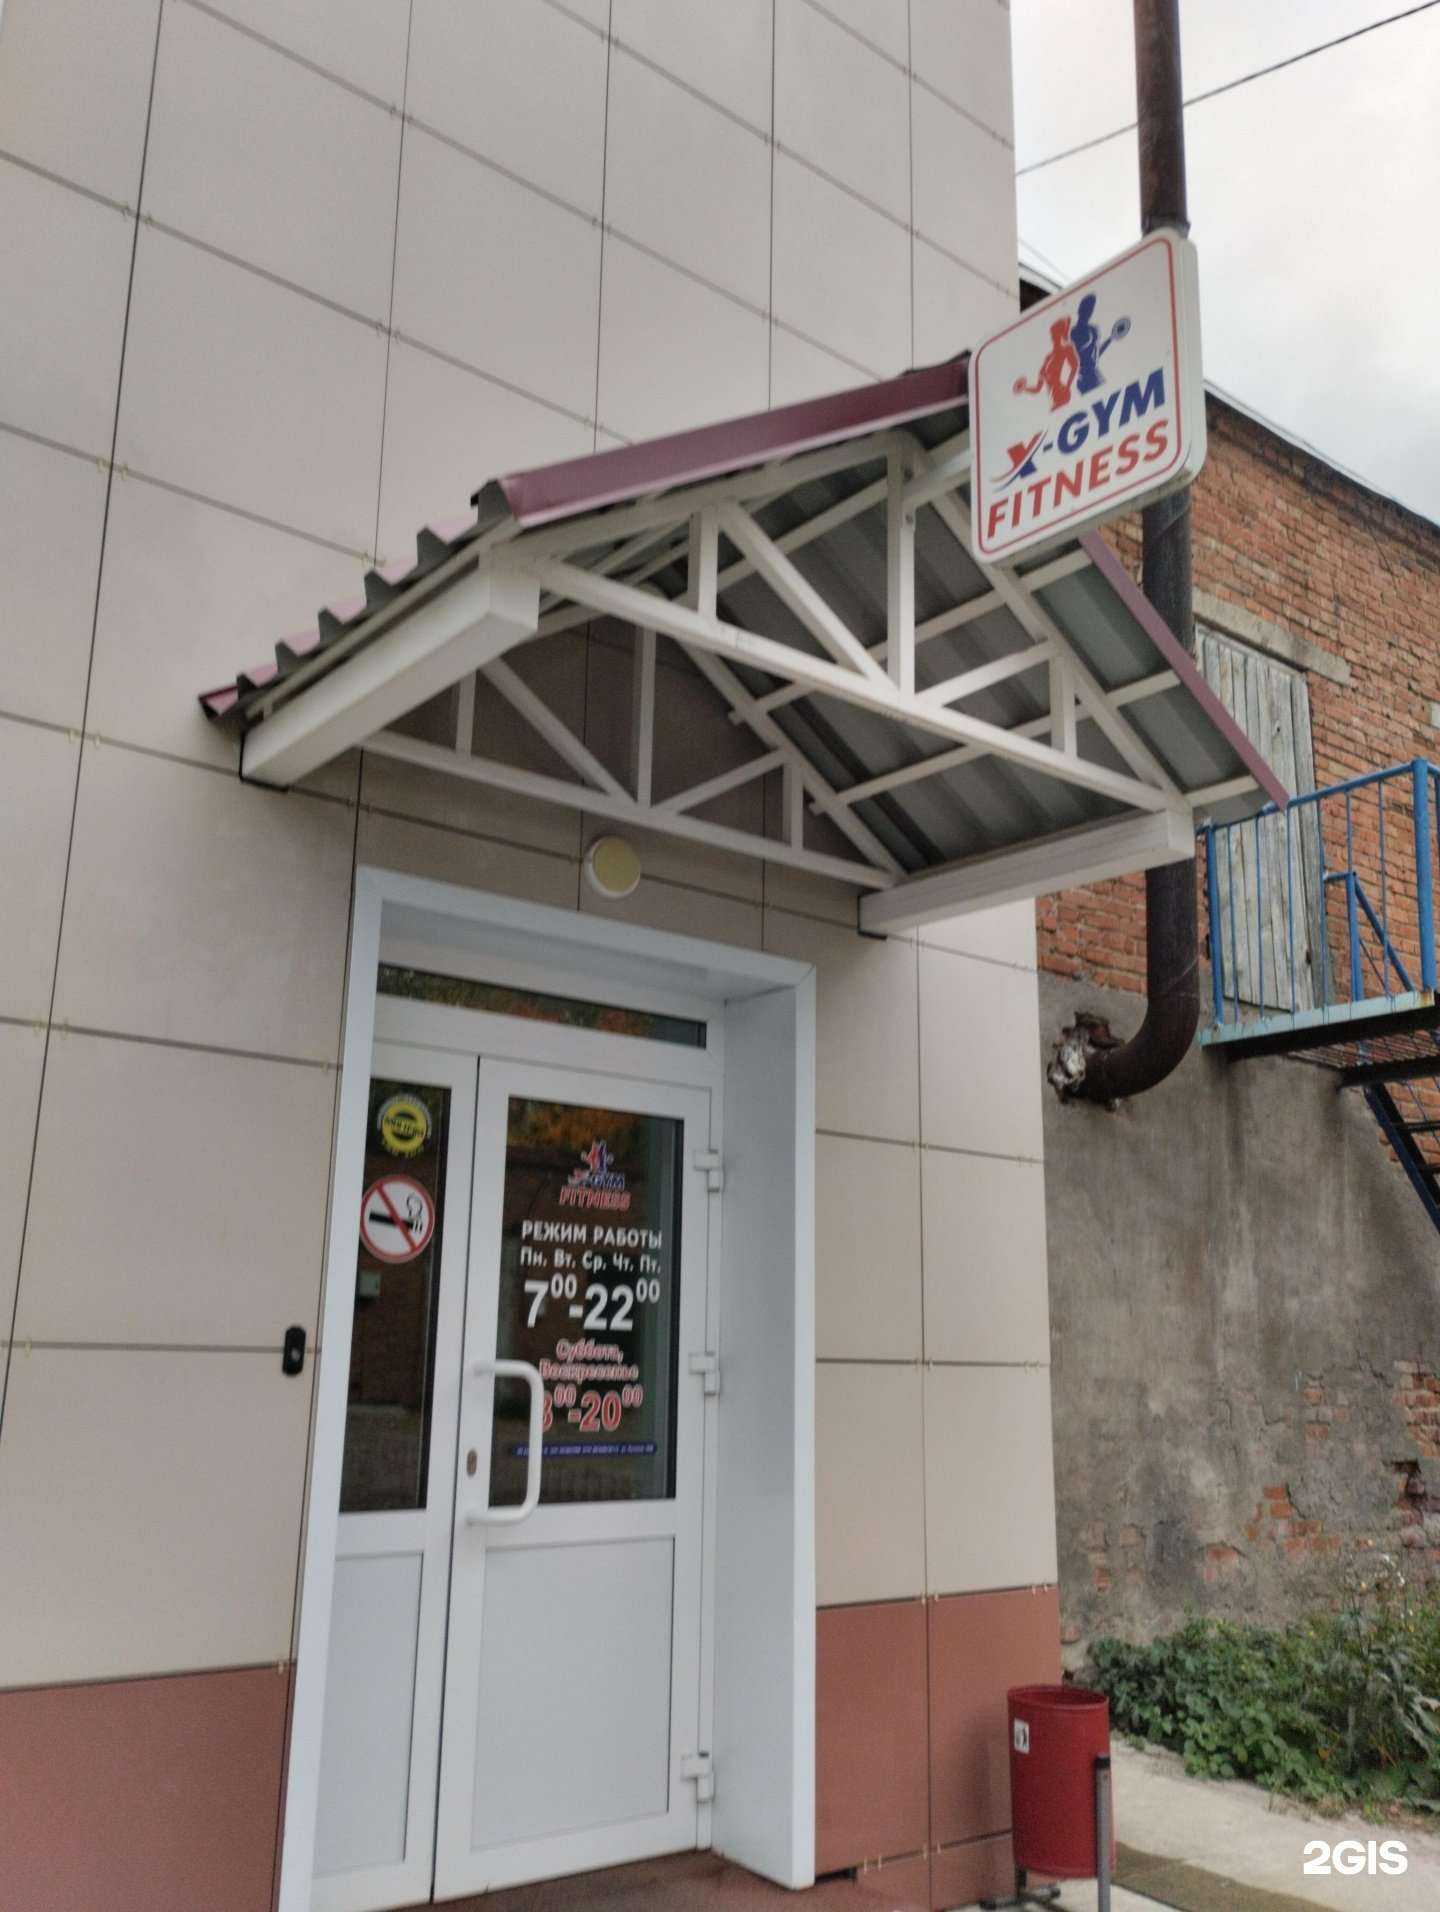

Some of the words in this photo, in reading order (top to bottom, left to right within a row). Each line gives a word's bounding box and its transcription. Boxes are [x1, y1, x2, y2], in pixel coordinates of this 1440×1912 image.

[987, 419, 1169, 539] FITNESS
[990, 367, 1166, 491] X-GYM
[522, 1220, 587, 1244] РЕЖИМ
[593, 1225, 662, 1249] РАБОТЫ
